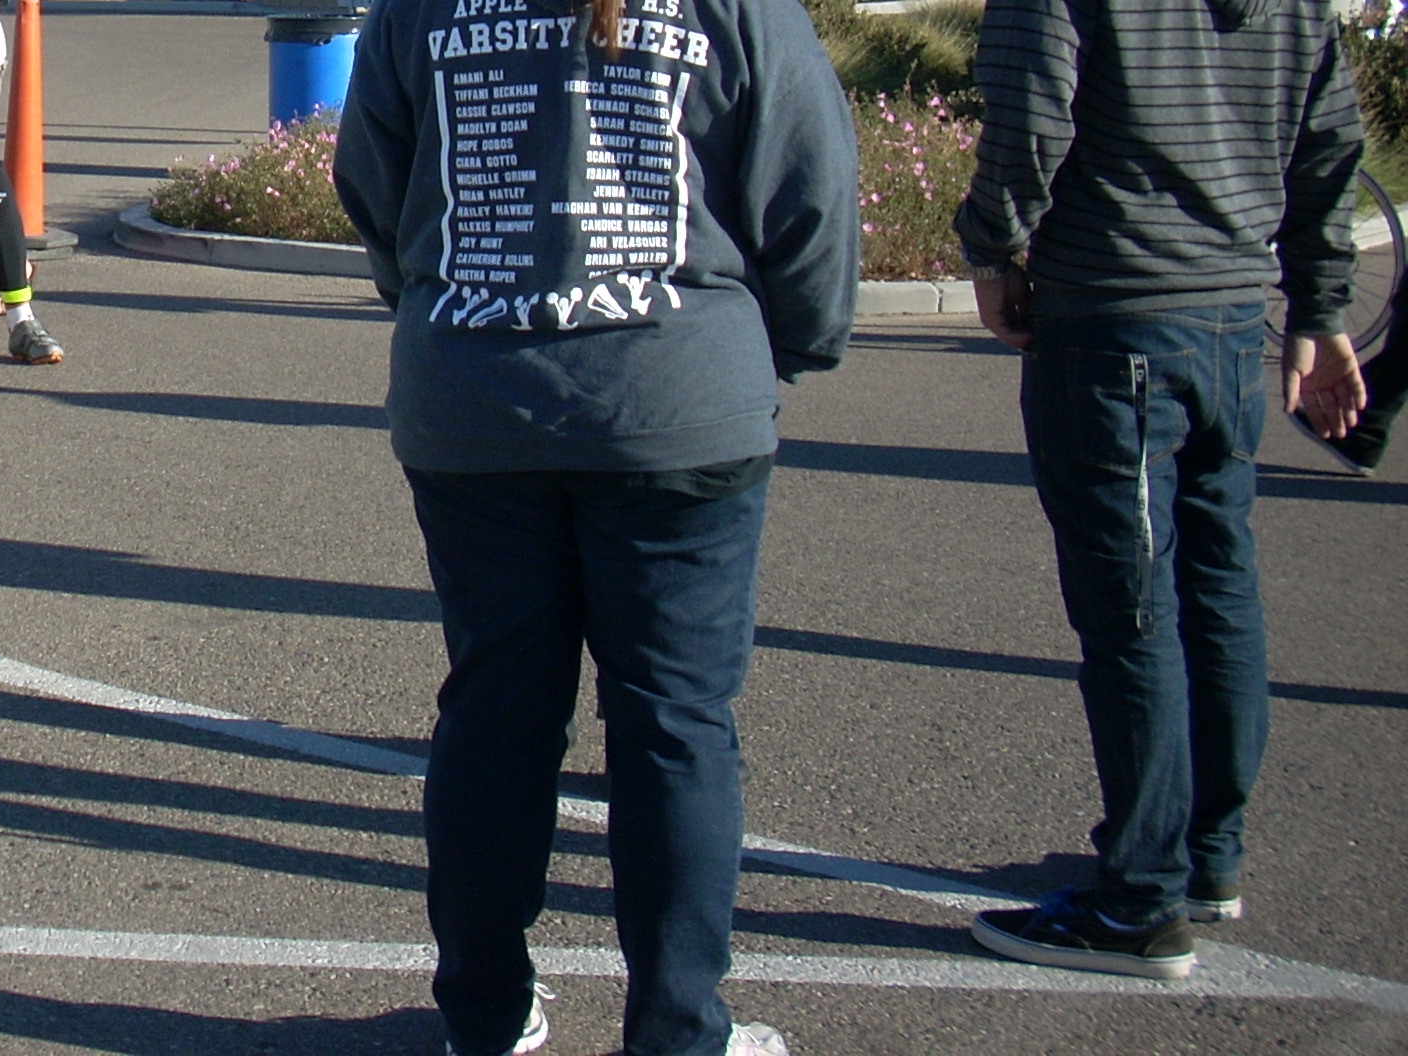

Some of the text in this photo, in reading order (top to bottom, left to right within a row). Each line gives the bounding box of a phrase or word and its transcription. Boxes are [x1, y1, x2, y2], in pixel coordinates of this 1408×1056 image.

[427, 16, 577, 61] VARSITY
[488, 69, 504, 82] ALI
[603, 65, 642, 81] TAYLOR
[492, 84, 538, 99] BECKHAM
[455, 101, 536, 118] CASSIE CLAWSON
[457, 119, 528, 135] MADELYN DOAN
[590, 116, 625, 130] SARAH
[456, 139, 478, 152] HOPE
[589, 133, 673, 153] KENNEDY SMITH
[455, 156, 482, 169] CIARA
[586, 150, 672, 170] SCARLETT SMITH
[456, 169, 537, 186] MICHELLE GRIMM
[586, 167, 671, 186] ISAIAH STEARNS
[488, 187, 526, 200] HATLEY
[593, 185, 670, 201] JENNA TILLETT
[457, 203, 534, 218] HAILEY HAWKINS
[551, 201, 669, 217] MEAGHAN VAN KEMPEN
[457, 221, 492, 232] ALEXIS
[580, 219, 668, 233] CANDICE VARGAS
[458, 236, 477, 249] JOY
[589, 236, 668, 249] ARI VELASQUEZ
[455, 252, 503, 265] CATHERINE
[584, 252, 668, 266] BRIANA WALLER
[454, 268, 516, 283] ARETHA ROPER
